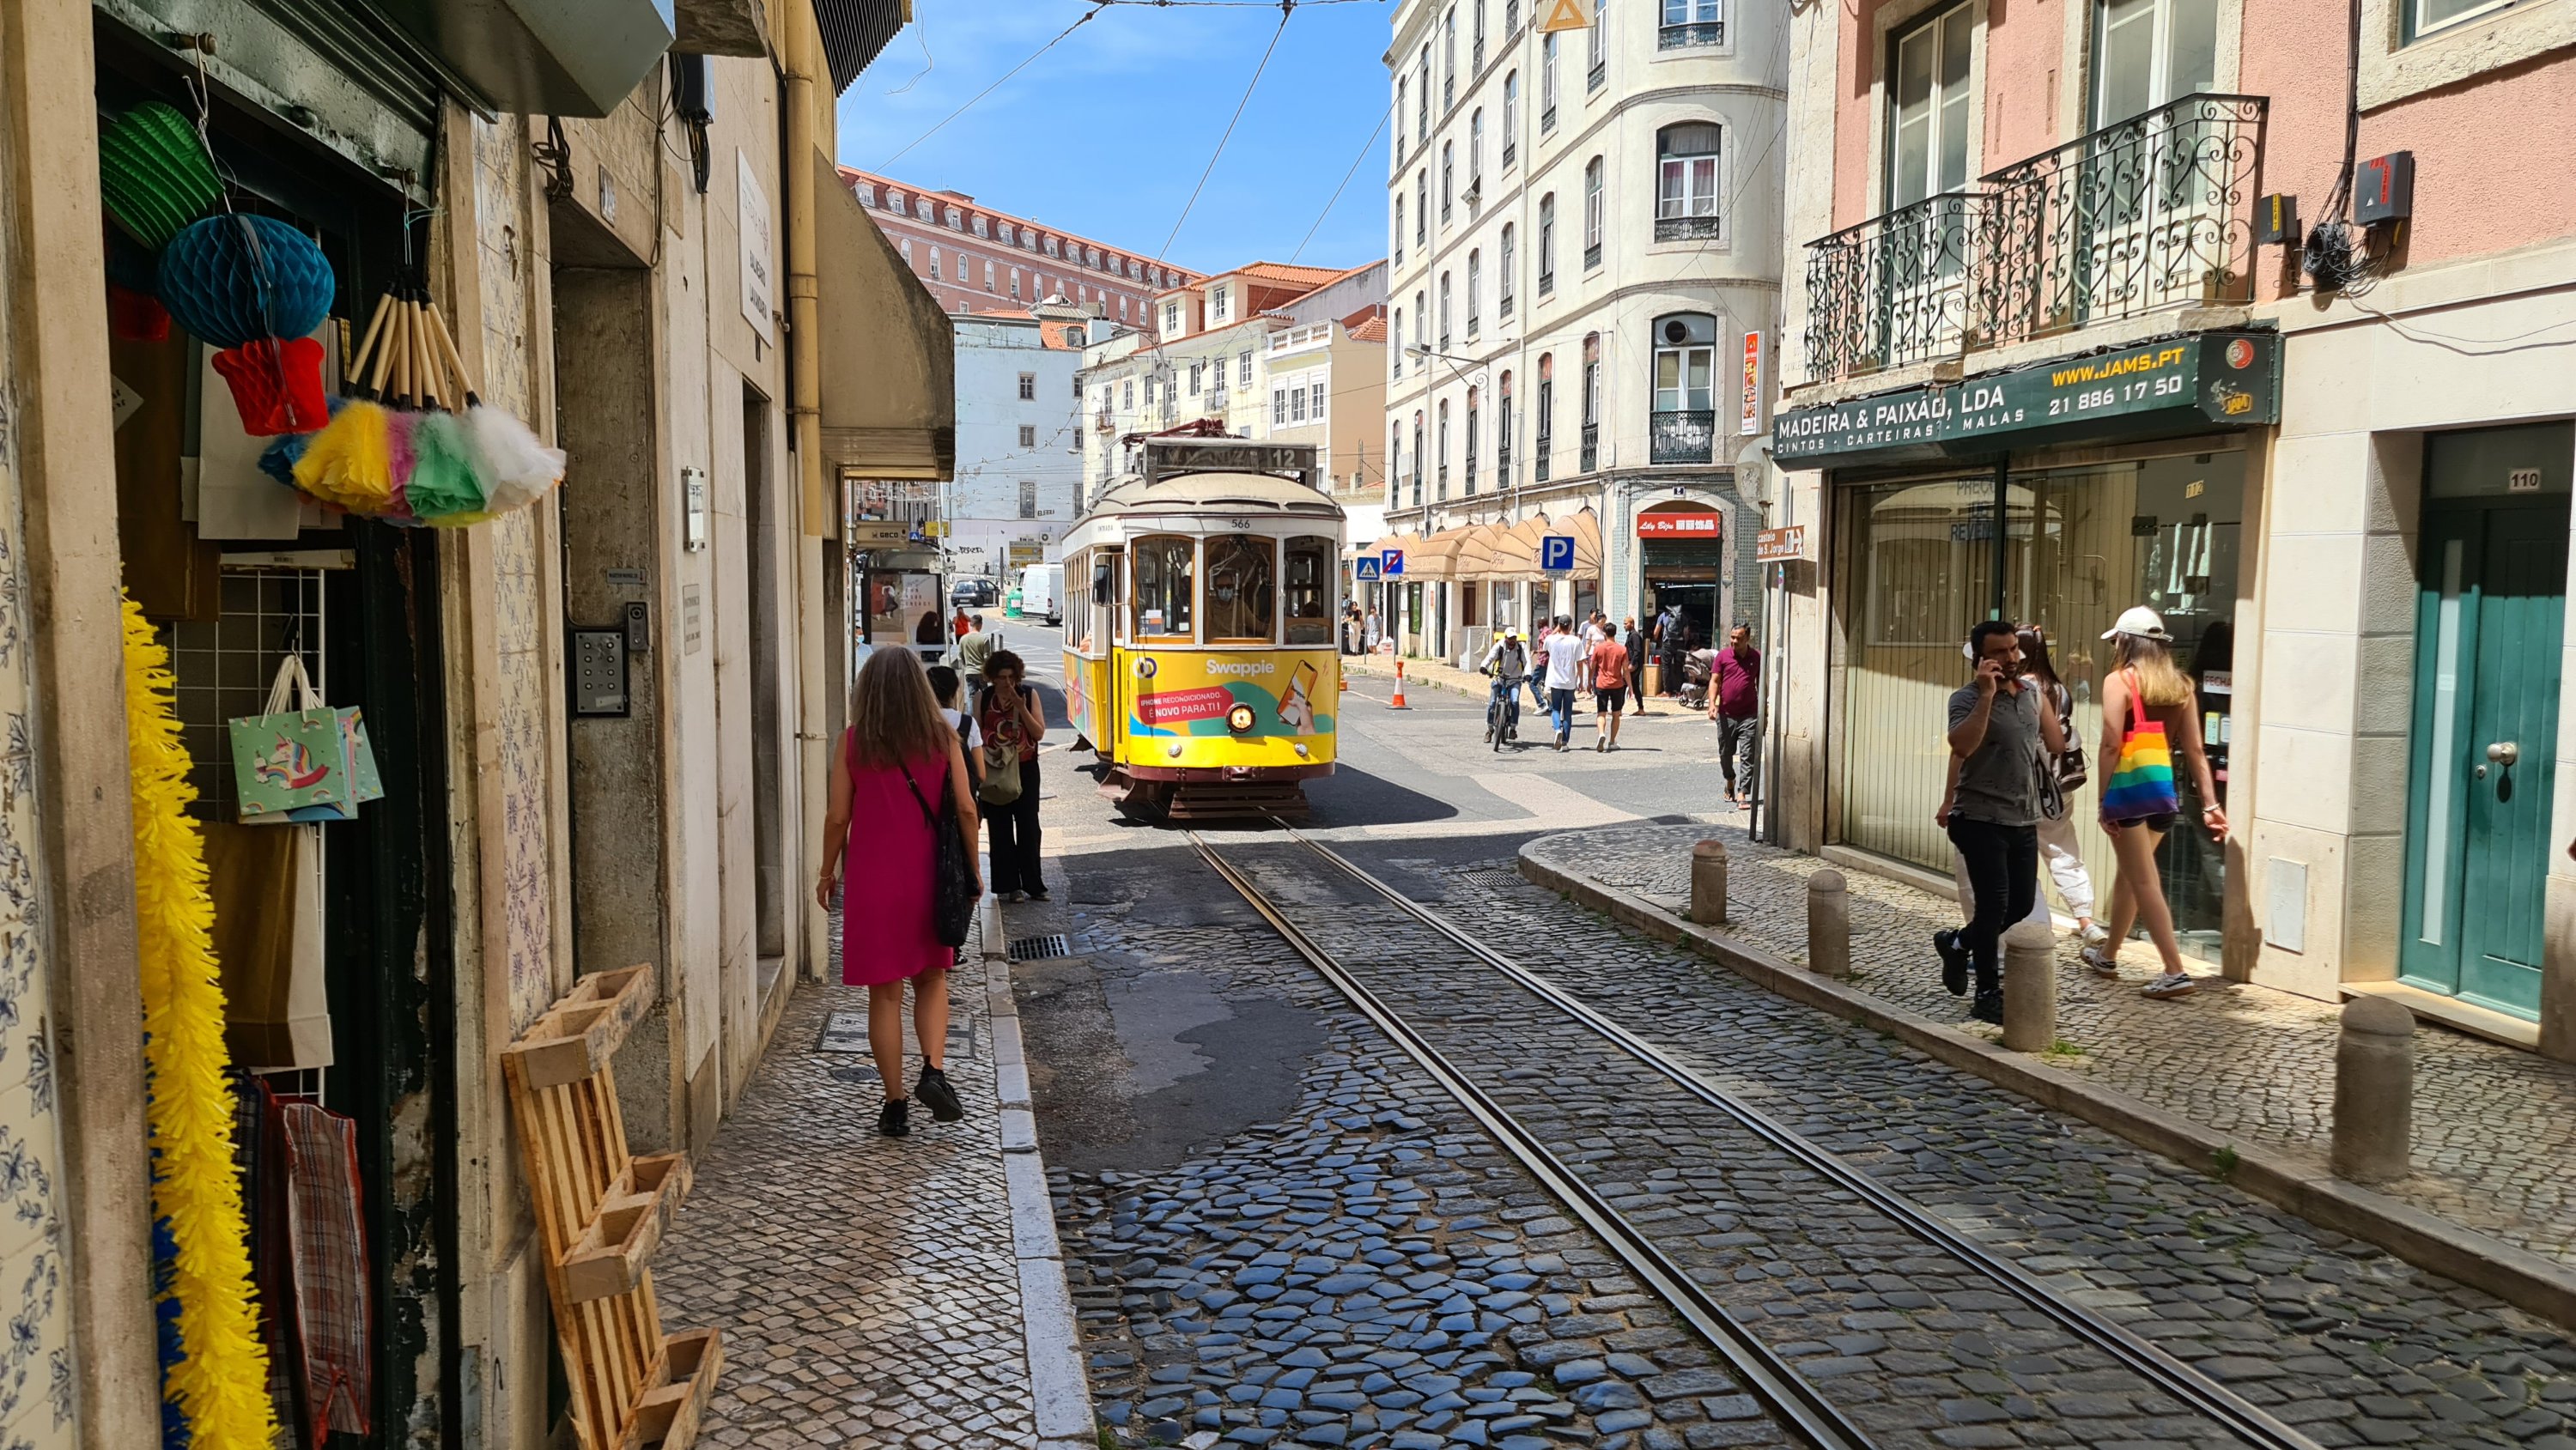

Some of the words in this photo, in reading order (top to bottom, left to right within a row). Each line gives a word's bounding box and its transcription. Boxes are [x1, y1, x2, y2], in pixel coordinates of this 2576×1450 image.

[2051, 347, 2184, 386] WWW.JAMS.PT
[2049, 397, 2069, 416] 21
[2078, 388, 2115, 410] 886
[2123, 381, 2148, 402] 17
[2154, 374, 2183, 396] 50
[1778, 412, 1850, 440] MADEIRA
[1856, 409, 1868, 429] &
[1875, 395, 1953, 426] PAIXÃO,
[1961, 385, 2004, 413] LDA
[1777, 439, 1825, 454] CINTOS
[1847, 424, 1933, 446] CARTEIRAS
[1963, 409, 2024, 430] MALAS
[1273, 449, 1295, 468] 12
[2512, 473, 2538, 487] 110
[1231, 519, 1250, 529] 566
[1639, 521, 1656, 531] Lily
[1758, 531, 1776, 543] castelo
[1548, 539, 1568, 567] P
[1757, 544, 1764, 555] de
[1770, 543, 1784, 556] Jorge
[1206, 659, 1274, 676] Swappie
[1163, 692, 1222, 704] RECONDICIONADO.
[1149, 708, 1153, 718] É
[1155, 706, 1180, 718] NOVO
[1182, 704, 1205, 714] PARA
[1208, 702, 1215, 712] TI
